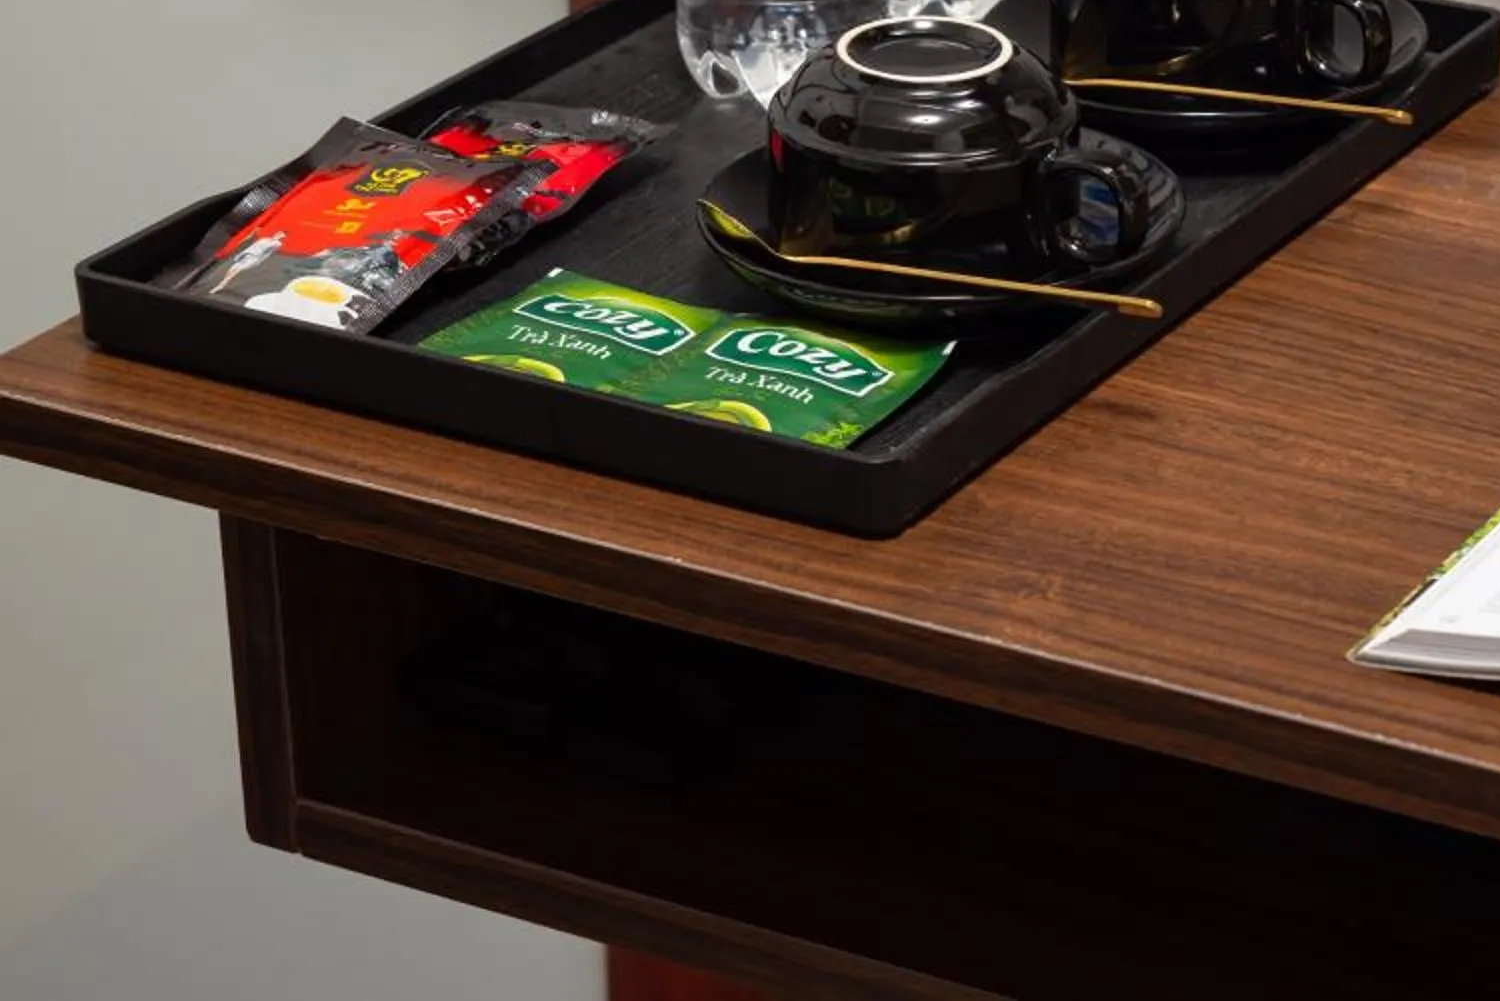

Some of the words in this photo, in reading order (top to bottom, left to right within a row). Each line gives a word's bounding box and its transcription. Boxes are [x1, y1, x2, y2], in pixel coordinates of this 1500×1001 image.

[543, 301, 670, 340] Cozy
[549, 331, 613, 360] Xanh
[736, 330, 868, 379] Cozy
[747, 374, 815, 404] Xanh
